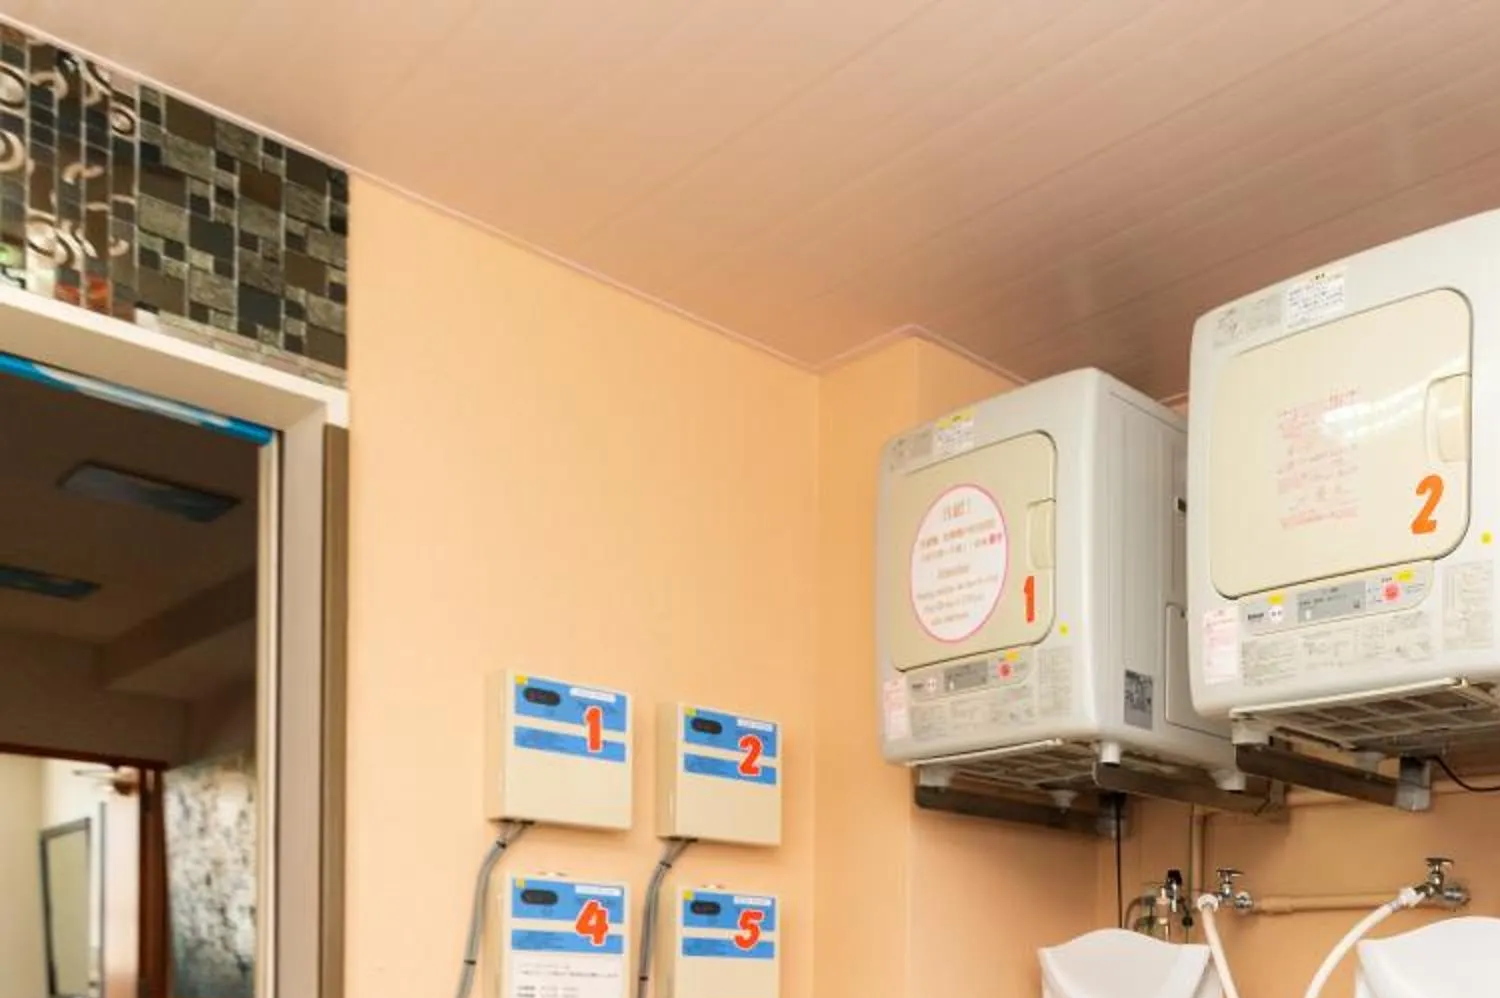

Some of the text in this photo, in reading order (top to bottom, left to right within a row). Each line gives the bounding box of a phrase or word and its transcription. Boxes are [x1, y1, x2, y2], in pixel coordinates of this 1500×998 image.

[1411, 474, 1444, 535] 2
[1023, 575, 1036, 623] 1
[585, 708, 602, 751] 1
[739, 735, 763, 775] 2
[575, 900, 609, 945] 4
[734, 910, 764, 949] 5
